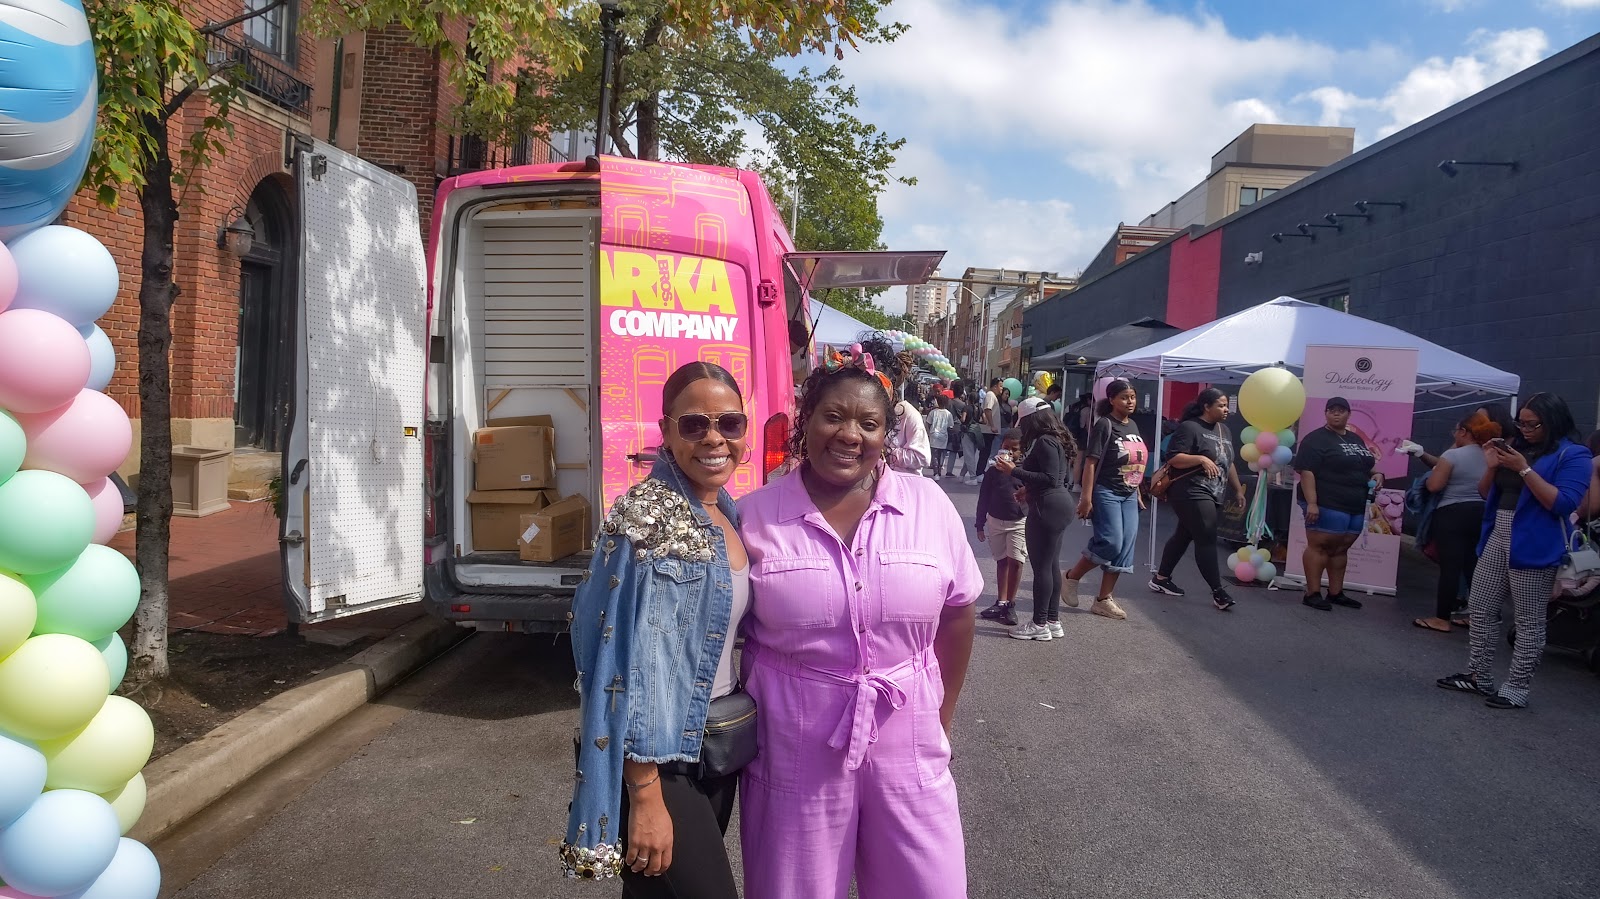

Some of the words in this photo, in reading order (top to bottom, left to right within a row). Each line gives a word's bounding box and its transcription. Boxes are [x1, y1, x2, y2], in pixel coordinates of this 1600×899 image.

[658, 259, 673, 307] BROS.
[609, 309, 739, 342] COMPANY
[1325, 371, 1393, 391] Dulceology
